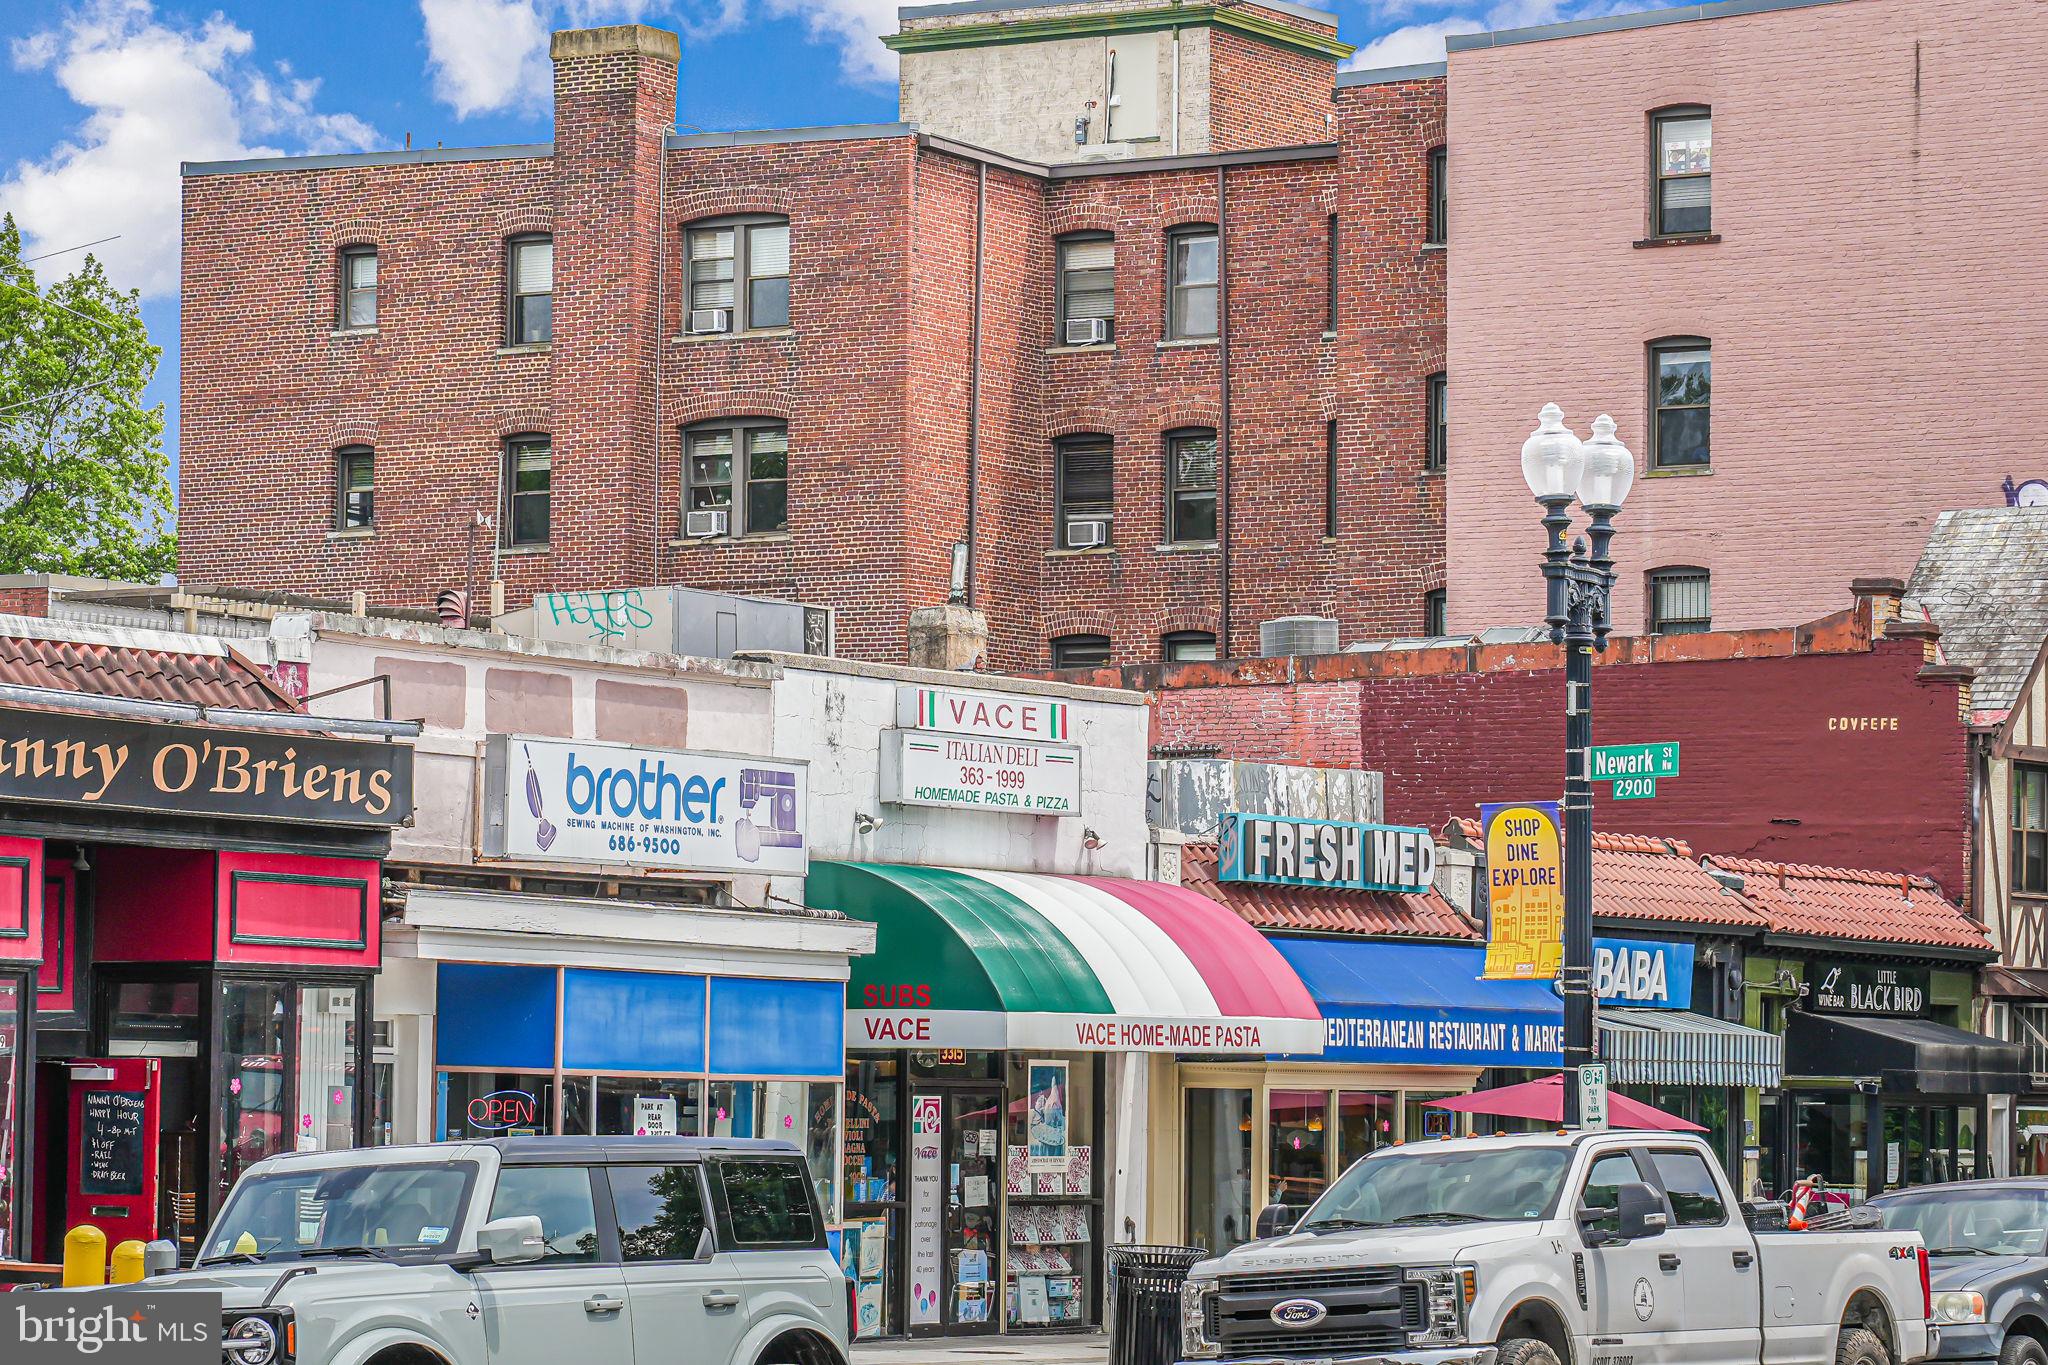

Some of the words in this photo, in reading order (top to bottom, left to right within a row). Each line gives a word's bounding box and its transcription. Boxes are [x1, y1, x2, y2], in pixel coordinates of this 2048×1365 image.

[950, 698, 1037, 732] VACE
[1828, 717, 1898, 731] COVFEFE
[946, 740, 1004, 764] ITALIAN
[1006, 747, 1038, 768] DELI
[1596, 748, 1654, 775] Newark
[1662, 747, 1672, 758] St
[0, 738, 128, 800] nny
[152, 738, 392, 815] O'Briens
[566, 752, 726, 823] brother
[1616, 778, 1652, 796] 2900
[914, 786, 980, 804] HOMEMADE
[985, 792, 1018, 806] PASTA
[1024, 795, 1032, 808] &
[1036, 796, 1068, 810] PIZZA
[566, 818, 596, 829] SEWING
[600, 821, 634, 832] MACHINE
[640, 824, 649, 832] OF
[654, 825, 704, 837] WASHINGTON,
[708, 828, 722, 838] INC.
[1504, 818, 1540, 838] SHOP
[608, 834, 680, 855] 686-9500
[1254, 820, 1360, 882] FRESH
[1374, 830, 1436, 886] MED
[1507, 843, 1539, 862] DINE
[1493, 867, 1556, 887] EXPLORE
[1877, 970, 1896, 984] LITTLE
[864, 984, 931, 1007] SUBS
[1818, 994, 1832, 1007] WINE
[1833, 994, 1844, 1008] BAR
[1850, 983, 1890, 1010] BLACK
[1894, 986, 1922, 1012] BIRD
[864, 1018, 931, 1040] VACE
[1076, 1022, 1116, 1046] VACE
[1121, 1024, 1211, 1047] HOME-MADE
[1216, 1025, 1261, 1047] PASTA
[1429, 1021, 1506, 1050] RESTAURANT
[1512, 1024, 1520, 1052] &
[87, 1094, 110, 1105] NANNY
[90, 1108, 111, 1118] HAPPY
[117, 1110, 139, 1124] HOUR
[468, 1098, 534, 1123] OPEN
[97, 1121, 104, 1135] 4
[100, 1140, 115, 1150] OFF
[923, 1267, 935, 1276] years
[1284, 1307, 1310, 1319] Ford
